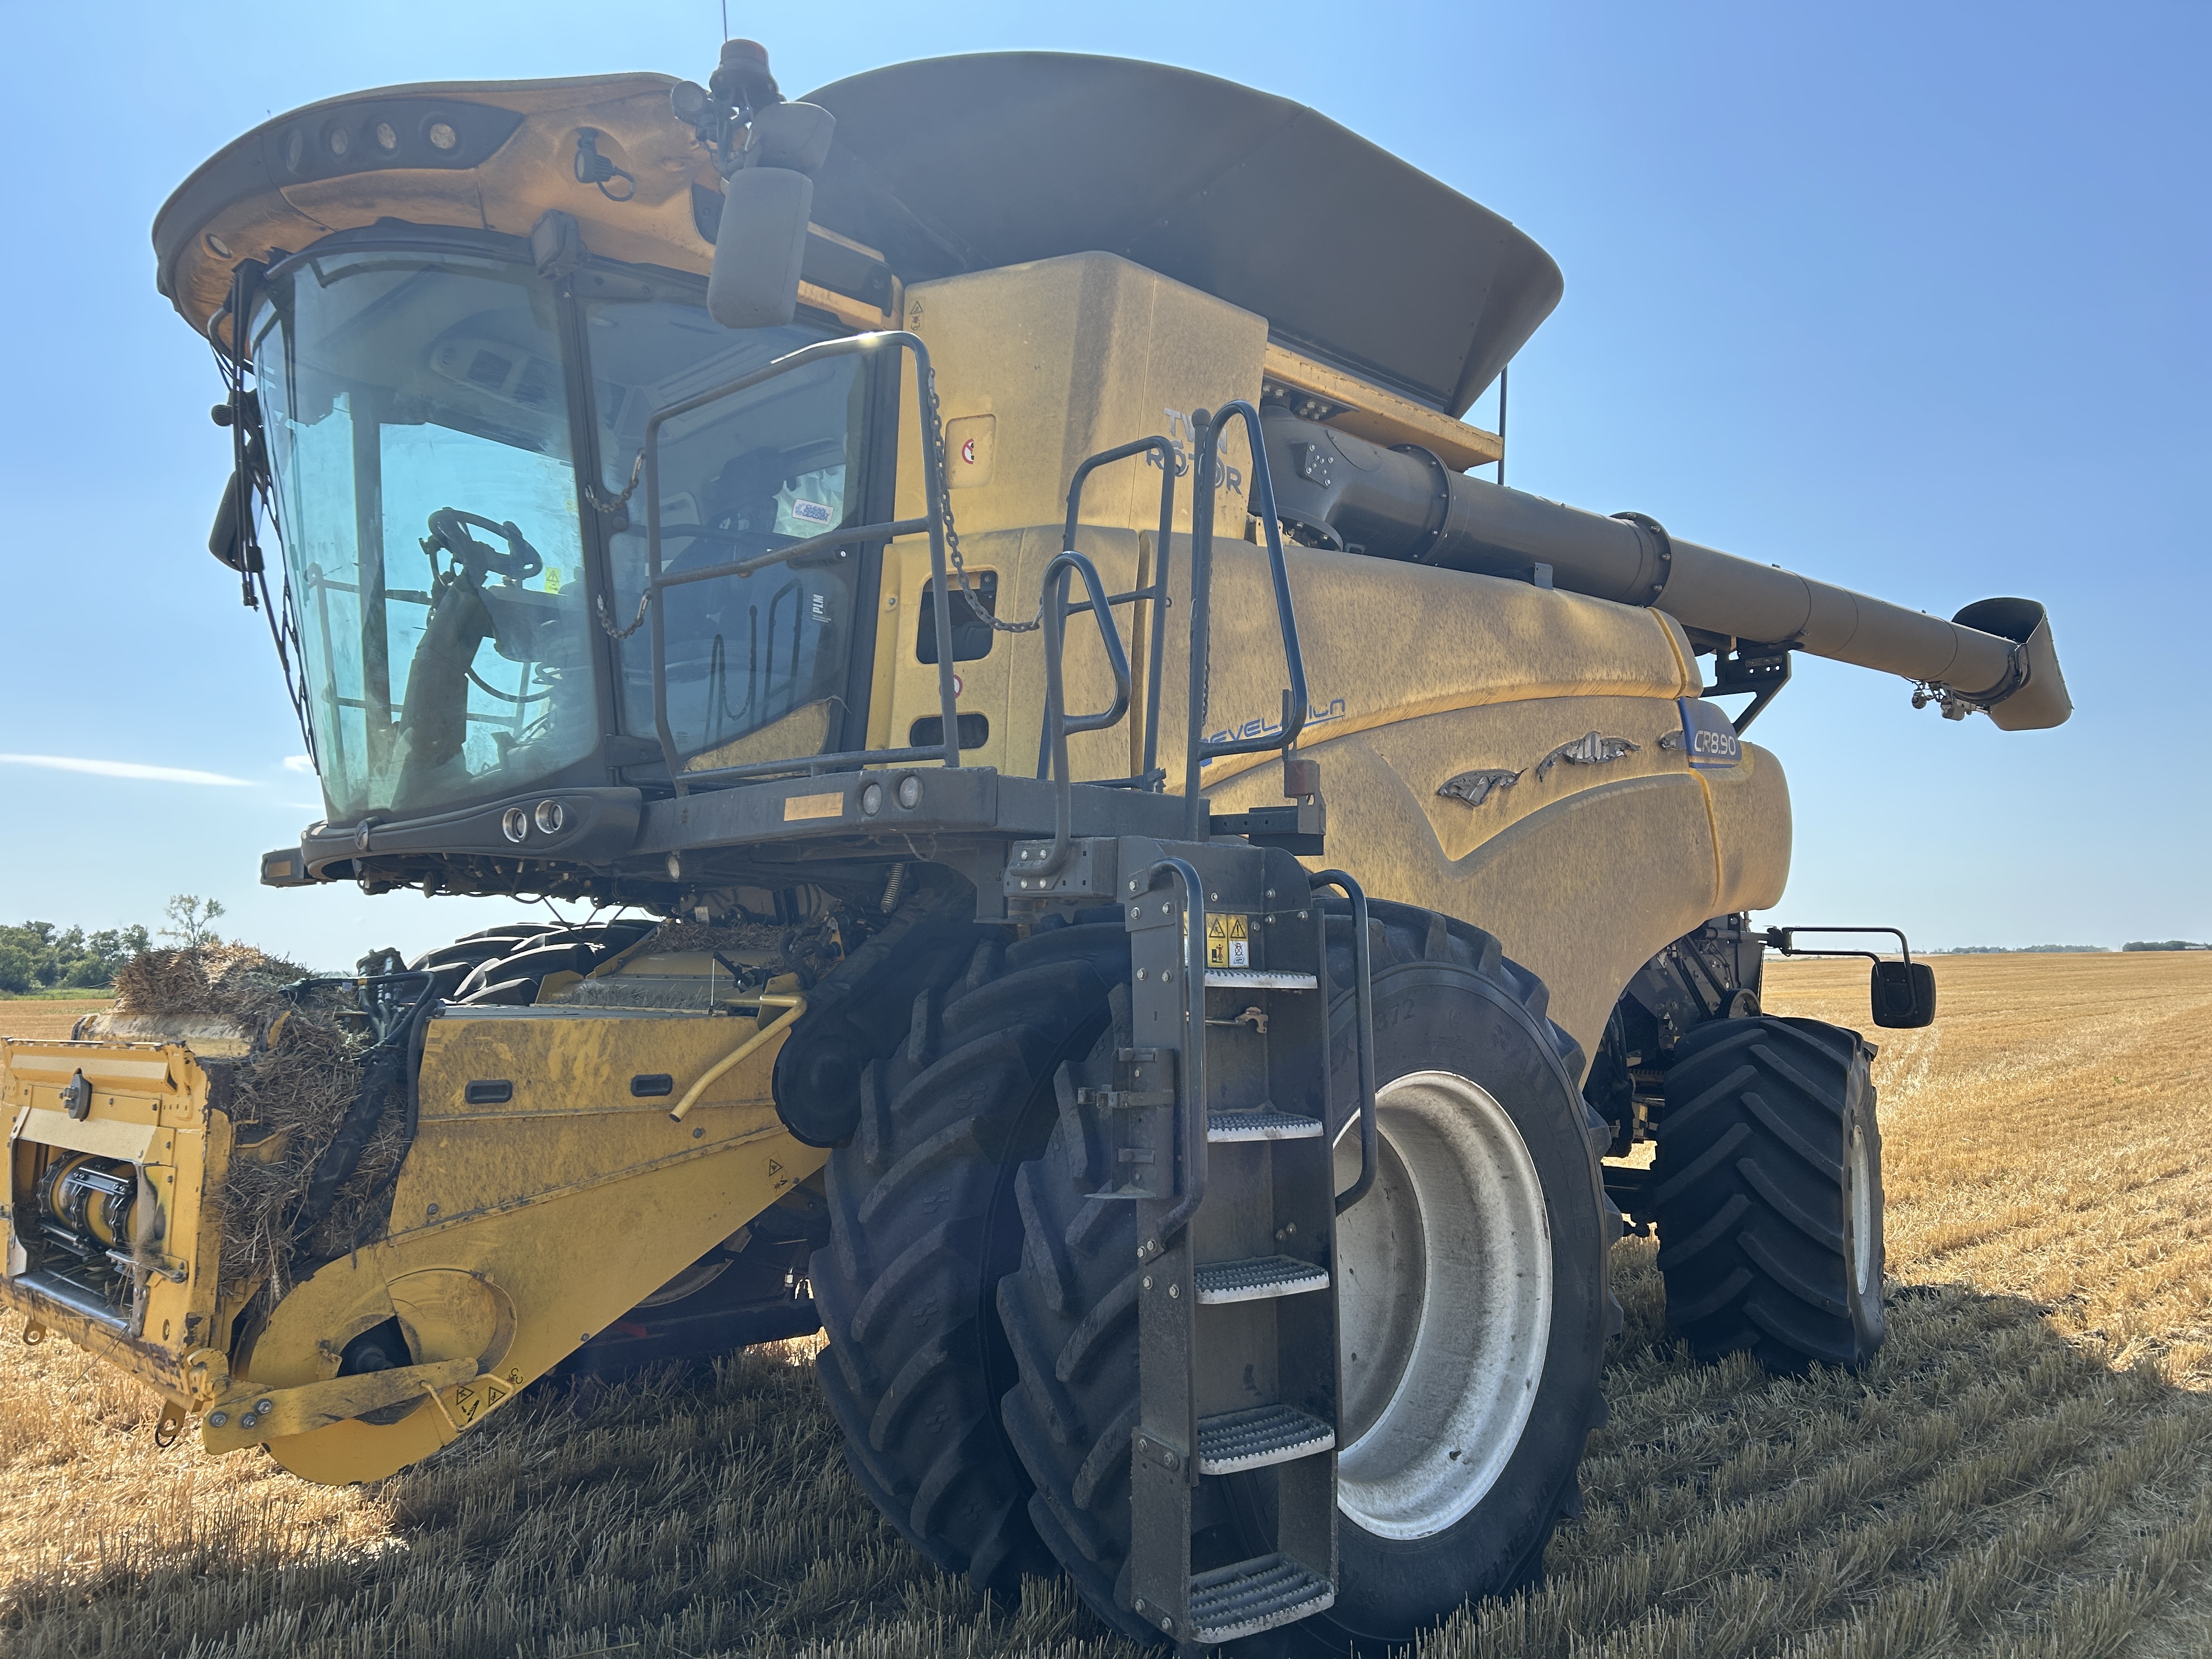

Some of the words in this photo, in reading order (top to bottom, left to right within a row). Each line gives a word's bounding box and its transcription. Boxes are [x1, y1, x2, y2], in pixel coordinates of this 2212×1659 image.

[1146, 443, 1243, 495] ROOR
[812, 594, 824, 614] PLM
[1694, 730, 1736, 755] CR8.90
